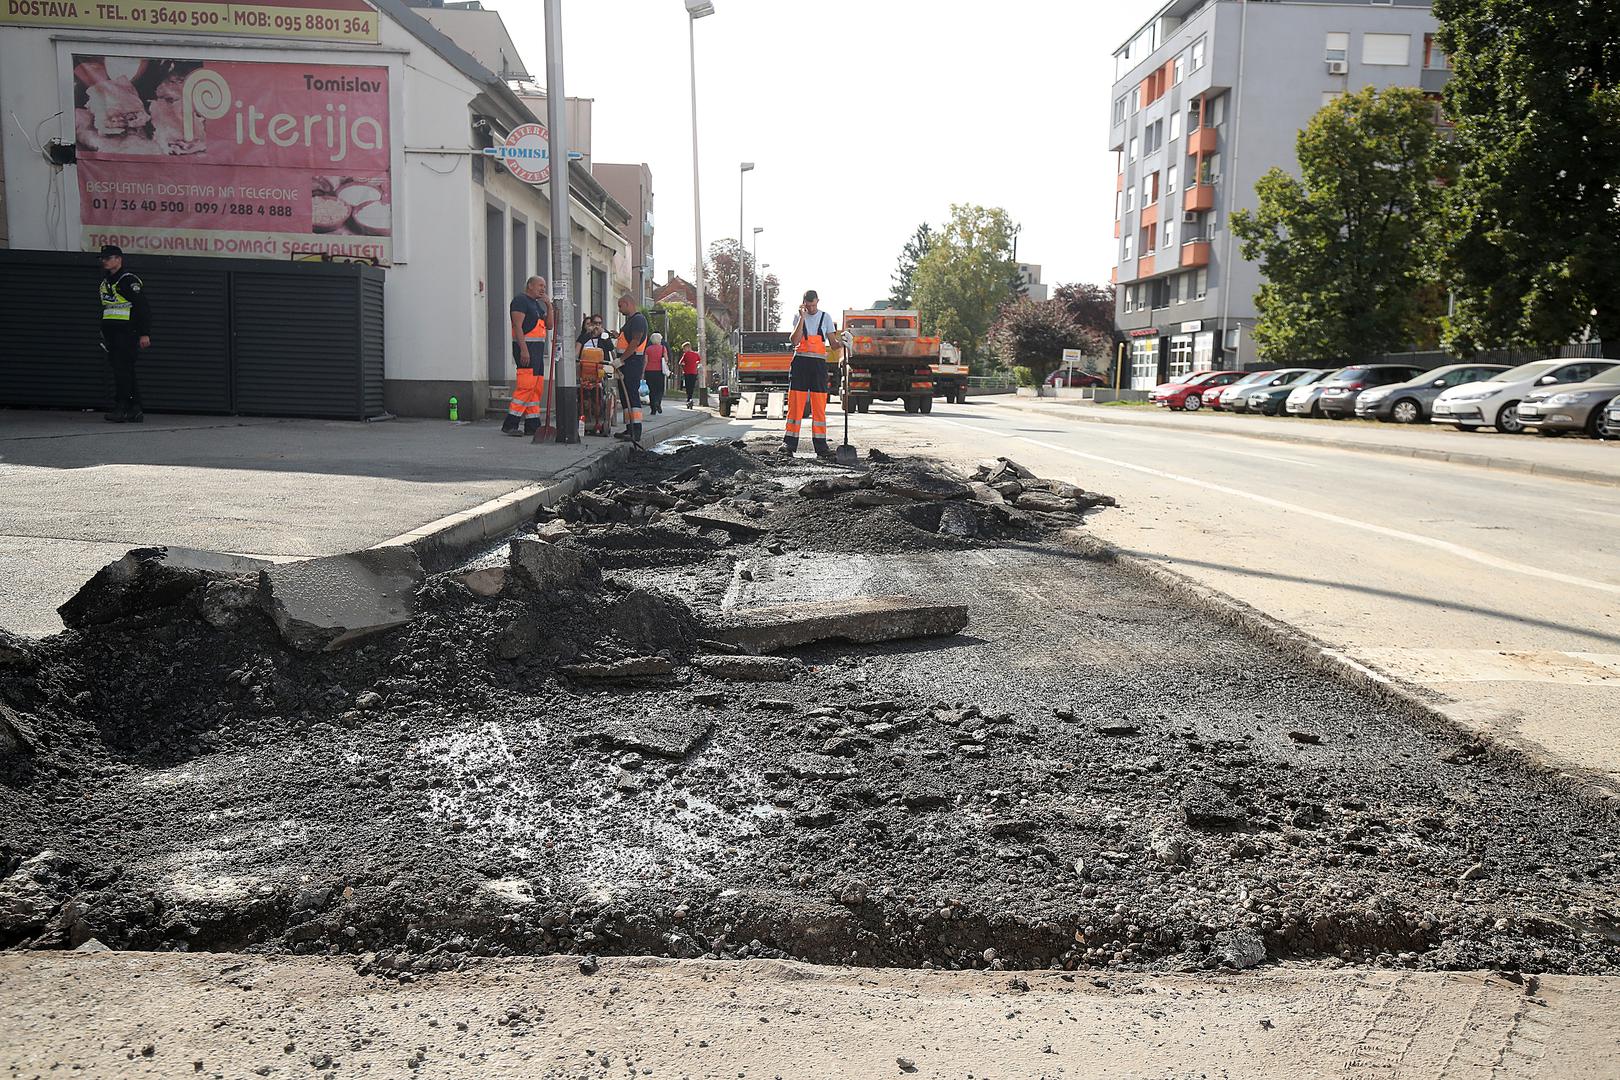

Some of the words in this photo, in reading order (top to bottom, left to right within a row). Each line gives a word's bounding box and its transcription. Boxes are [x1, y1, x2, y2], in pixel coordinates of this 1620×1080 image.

[9, 0, 78, 18] DOSTAVA
[97, 4, 127, 20] TEL.
[131, 8, 147, 23] 01
[150, 8, 188, 26] 3640
[191, 11, 218, 26] 500
[234, 12, 271, 28] MOB:
[274, 15, 301, 31] 095
[306, 15, 340, 32] 8801
[343, 17, 370, 35] 364
[303, 75, 382, 94] Tomislav
[182, 69, 383, 161] Piterija
[499, 147, 550, 159] TOMISL
[86, 181, 154, 195] BESPLATNA
[158, 183, 214, 197] DOSTAVA
[218, 186, 235, 198] NA
[239, 187, 298, 200] TELEFONE
[92, 198, 108, 209] 01
[120, 199, 137, 211] 36
[140, 200, 157, 212] 40
[160, 201, 184, 212] 500
[194, 202, 218, 214] 099
[230, 203, 253, 215] 288
[257, 204, 265, 216] 4
[269, 205, 292, 217] 888
[89, 233, 208, 252] TRADICIONALNI
[214, 235, 276, 254] DOMAĆI
